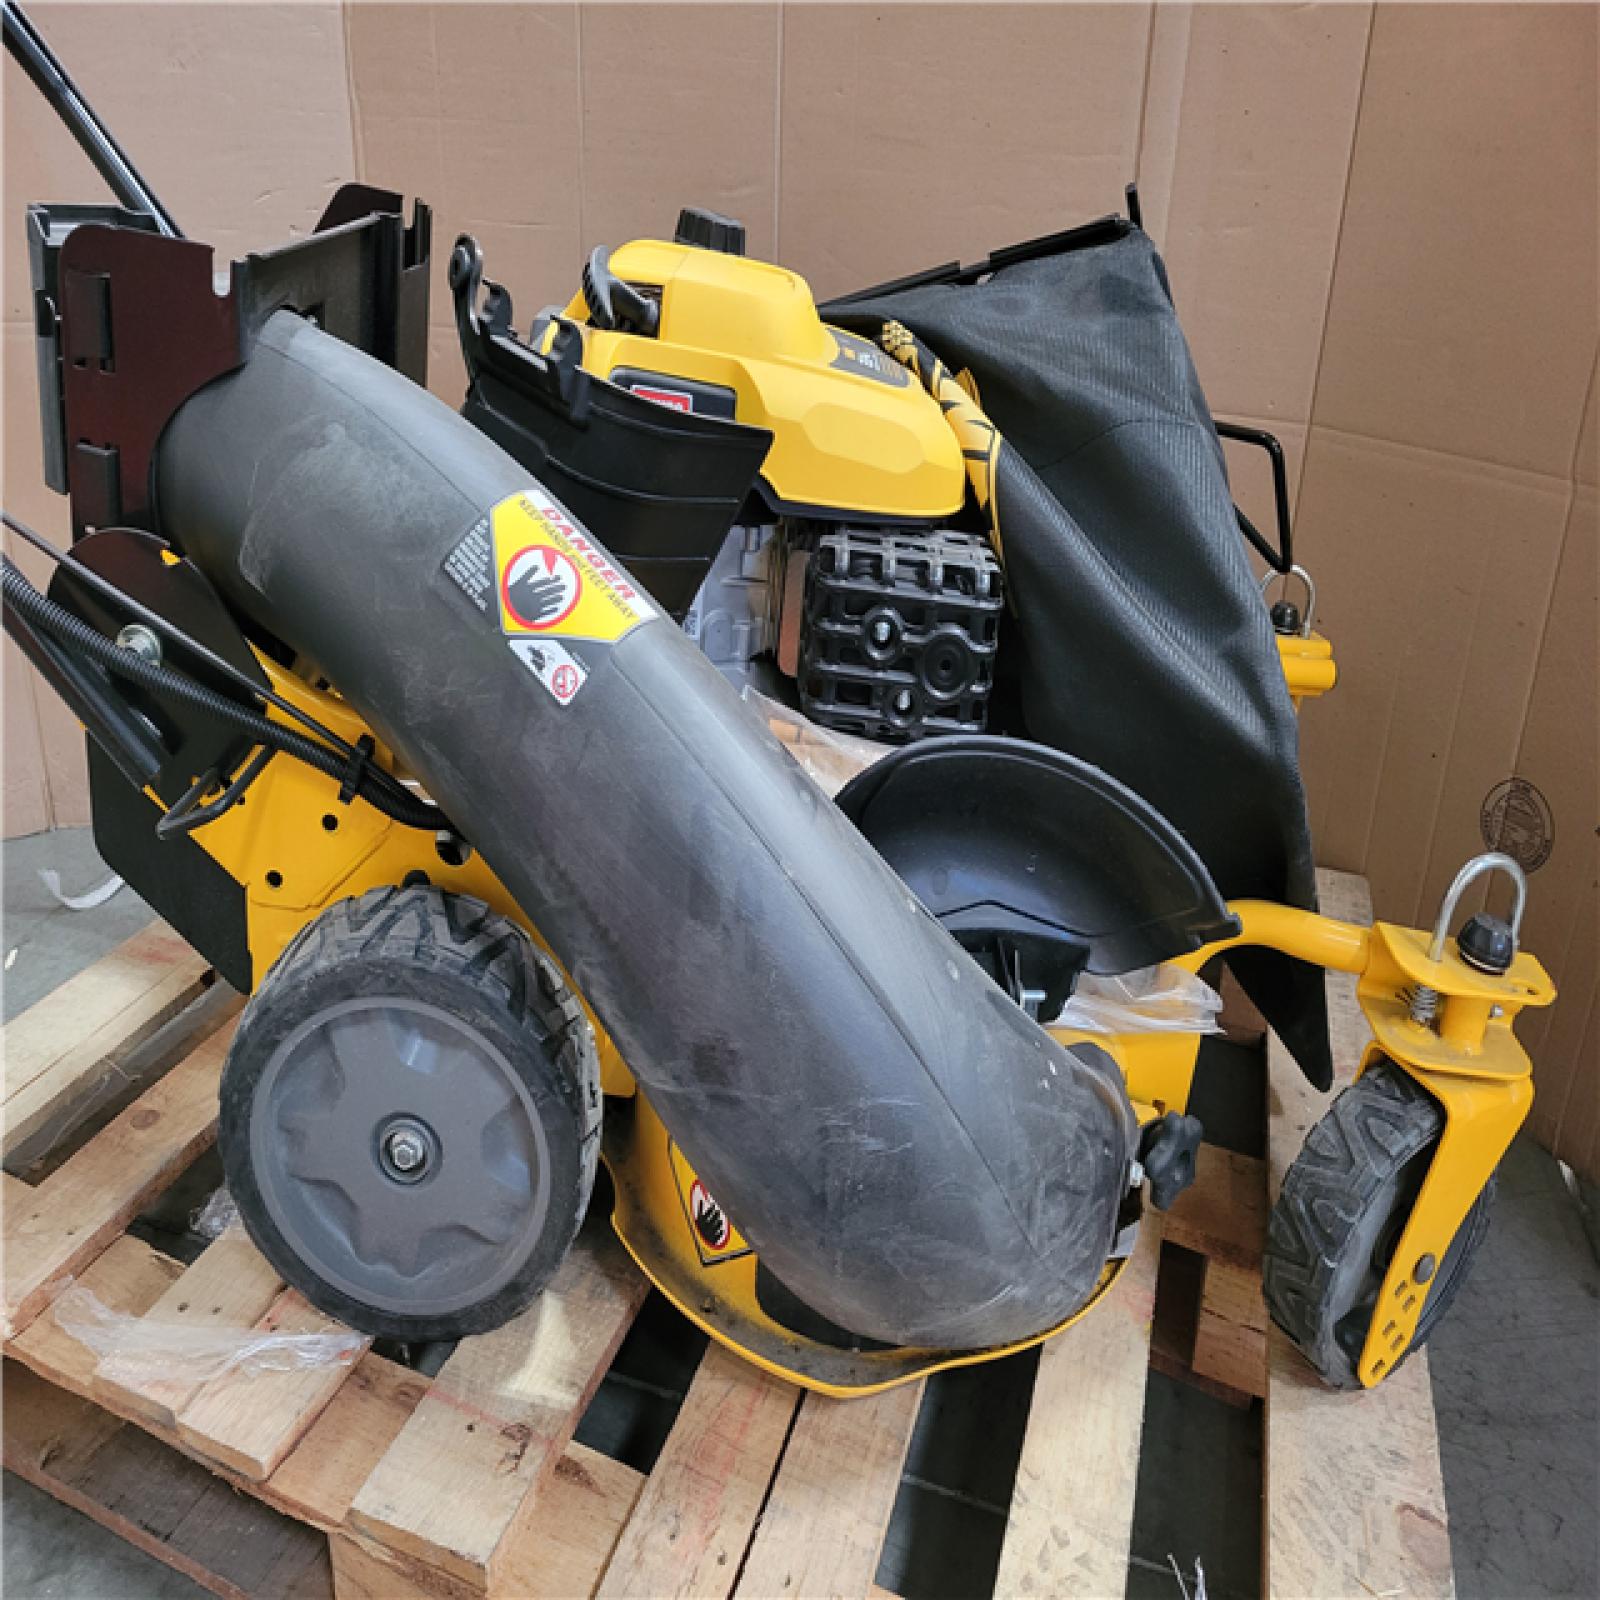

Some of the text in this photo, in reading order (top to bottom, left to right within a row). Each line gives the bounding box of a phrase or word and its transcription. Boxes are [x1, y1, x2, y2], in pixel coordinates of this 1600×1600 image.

[518, 498, 543, 523] KEEP
[584, 568, 610, 593] FEET
[606, 591, 636, 620] AWAY
[542, 507, 636, 602] DANGER
